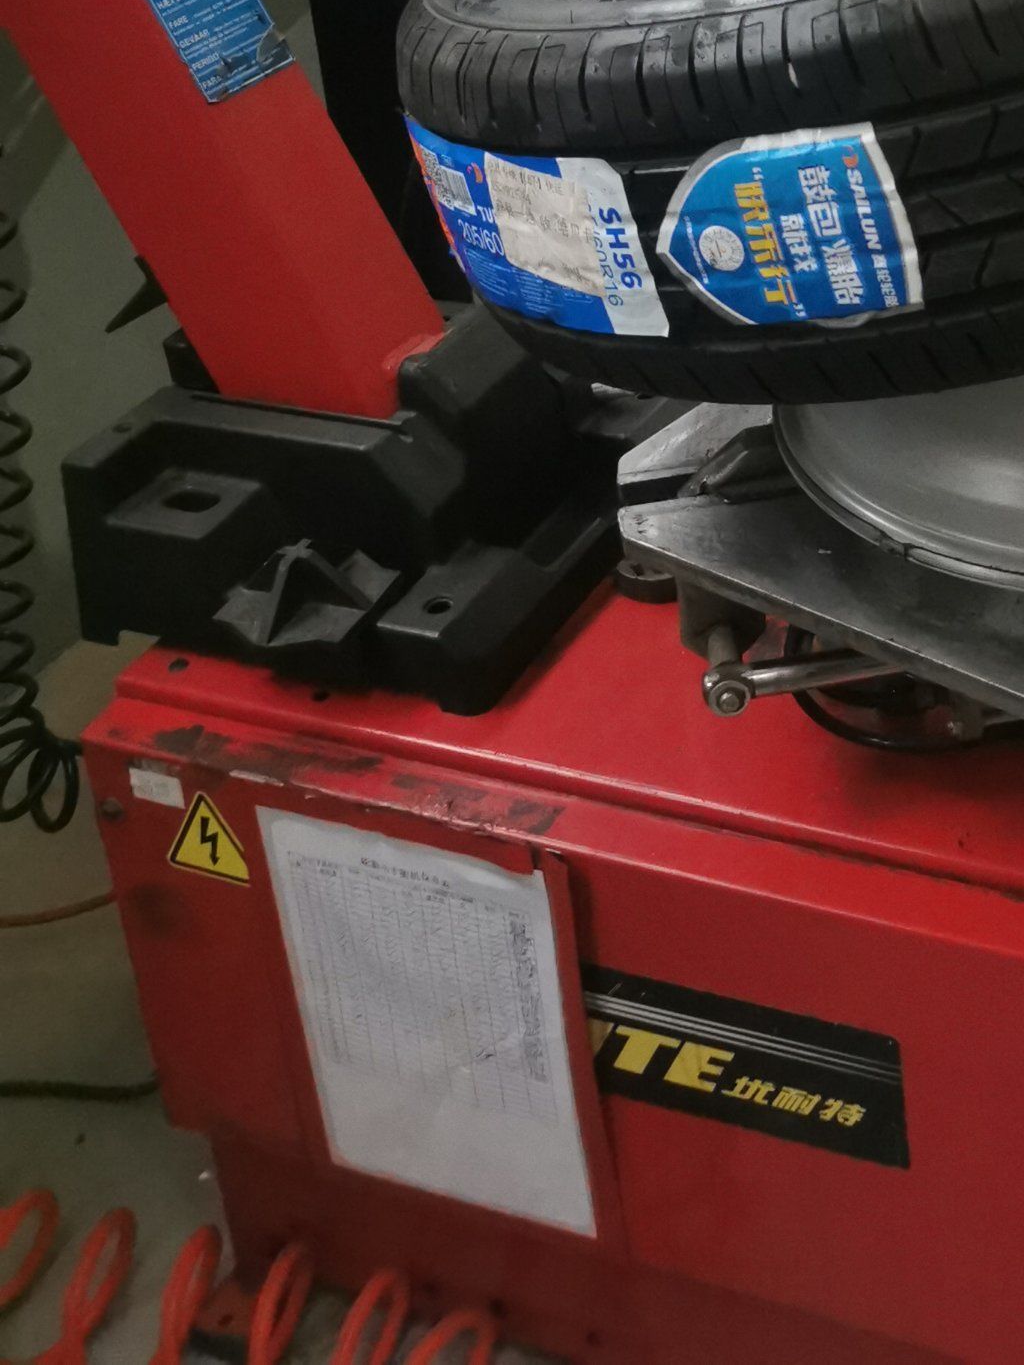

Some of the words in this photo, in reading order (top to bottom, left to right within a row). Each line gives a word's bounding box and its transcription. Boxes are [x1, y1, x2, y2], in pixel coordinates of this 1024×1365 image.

[598, 207, 643, 290] SH56
[846, 168, 882, 251] SAILUN
[720, 1073, 868, 1128] 优耐特
